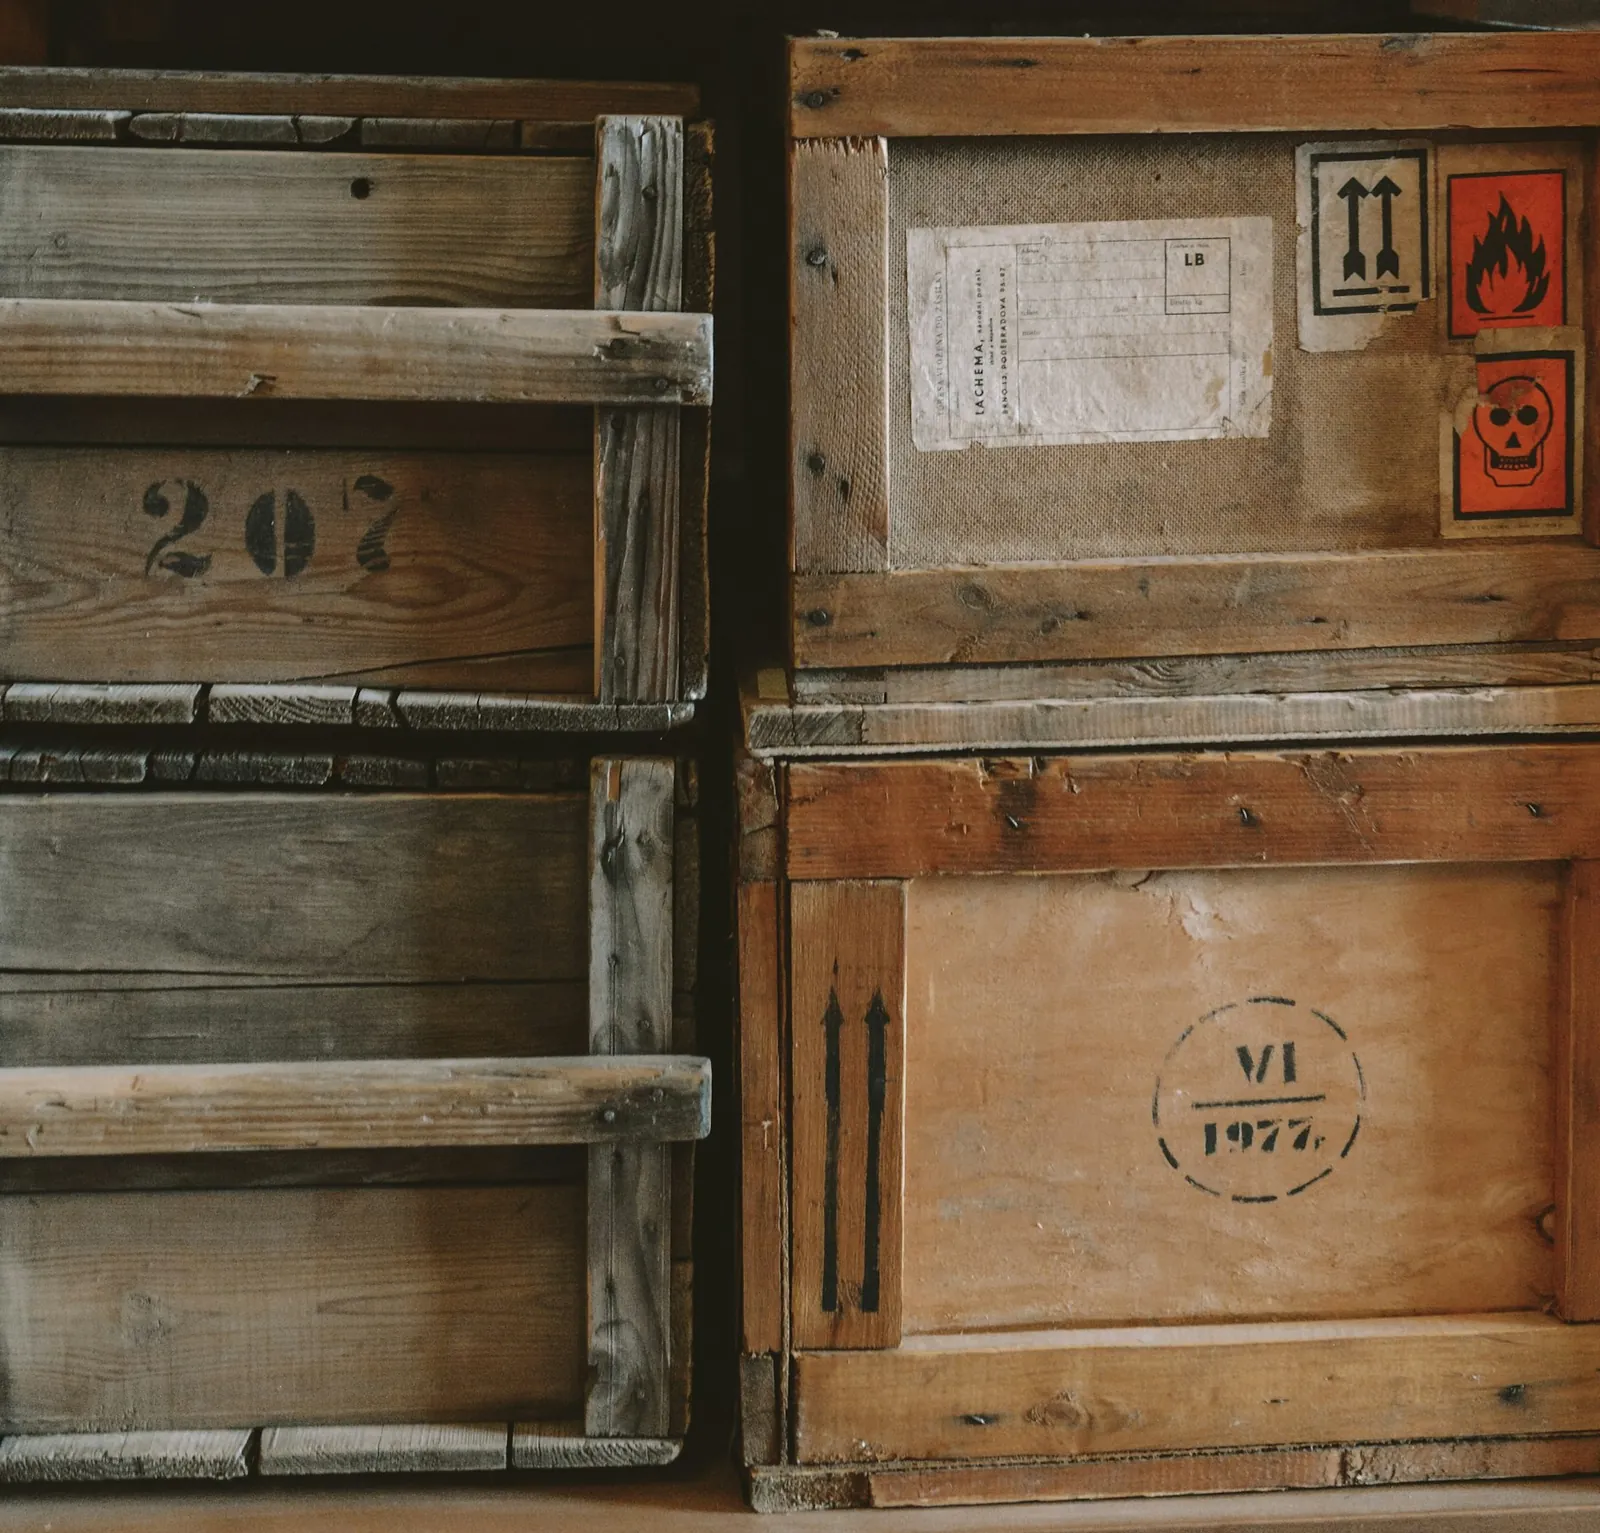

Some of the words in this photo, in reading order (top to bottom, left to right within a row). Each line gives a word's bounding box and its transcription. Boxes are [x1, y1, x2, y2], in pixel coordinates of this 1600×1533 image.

[1184, 253, 1204, 266] LB
[973, 339, 985, 416] LACHEMA,
[142, 475, 398, 578] 207
[1236, 1041, 1297, 1083] VI
